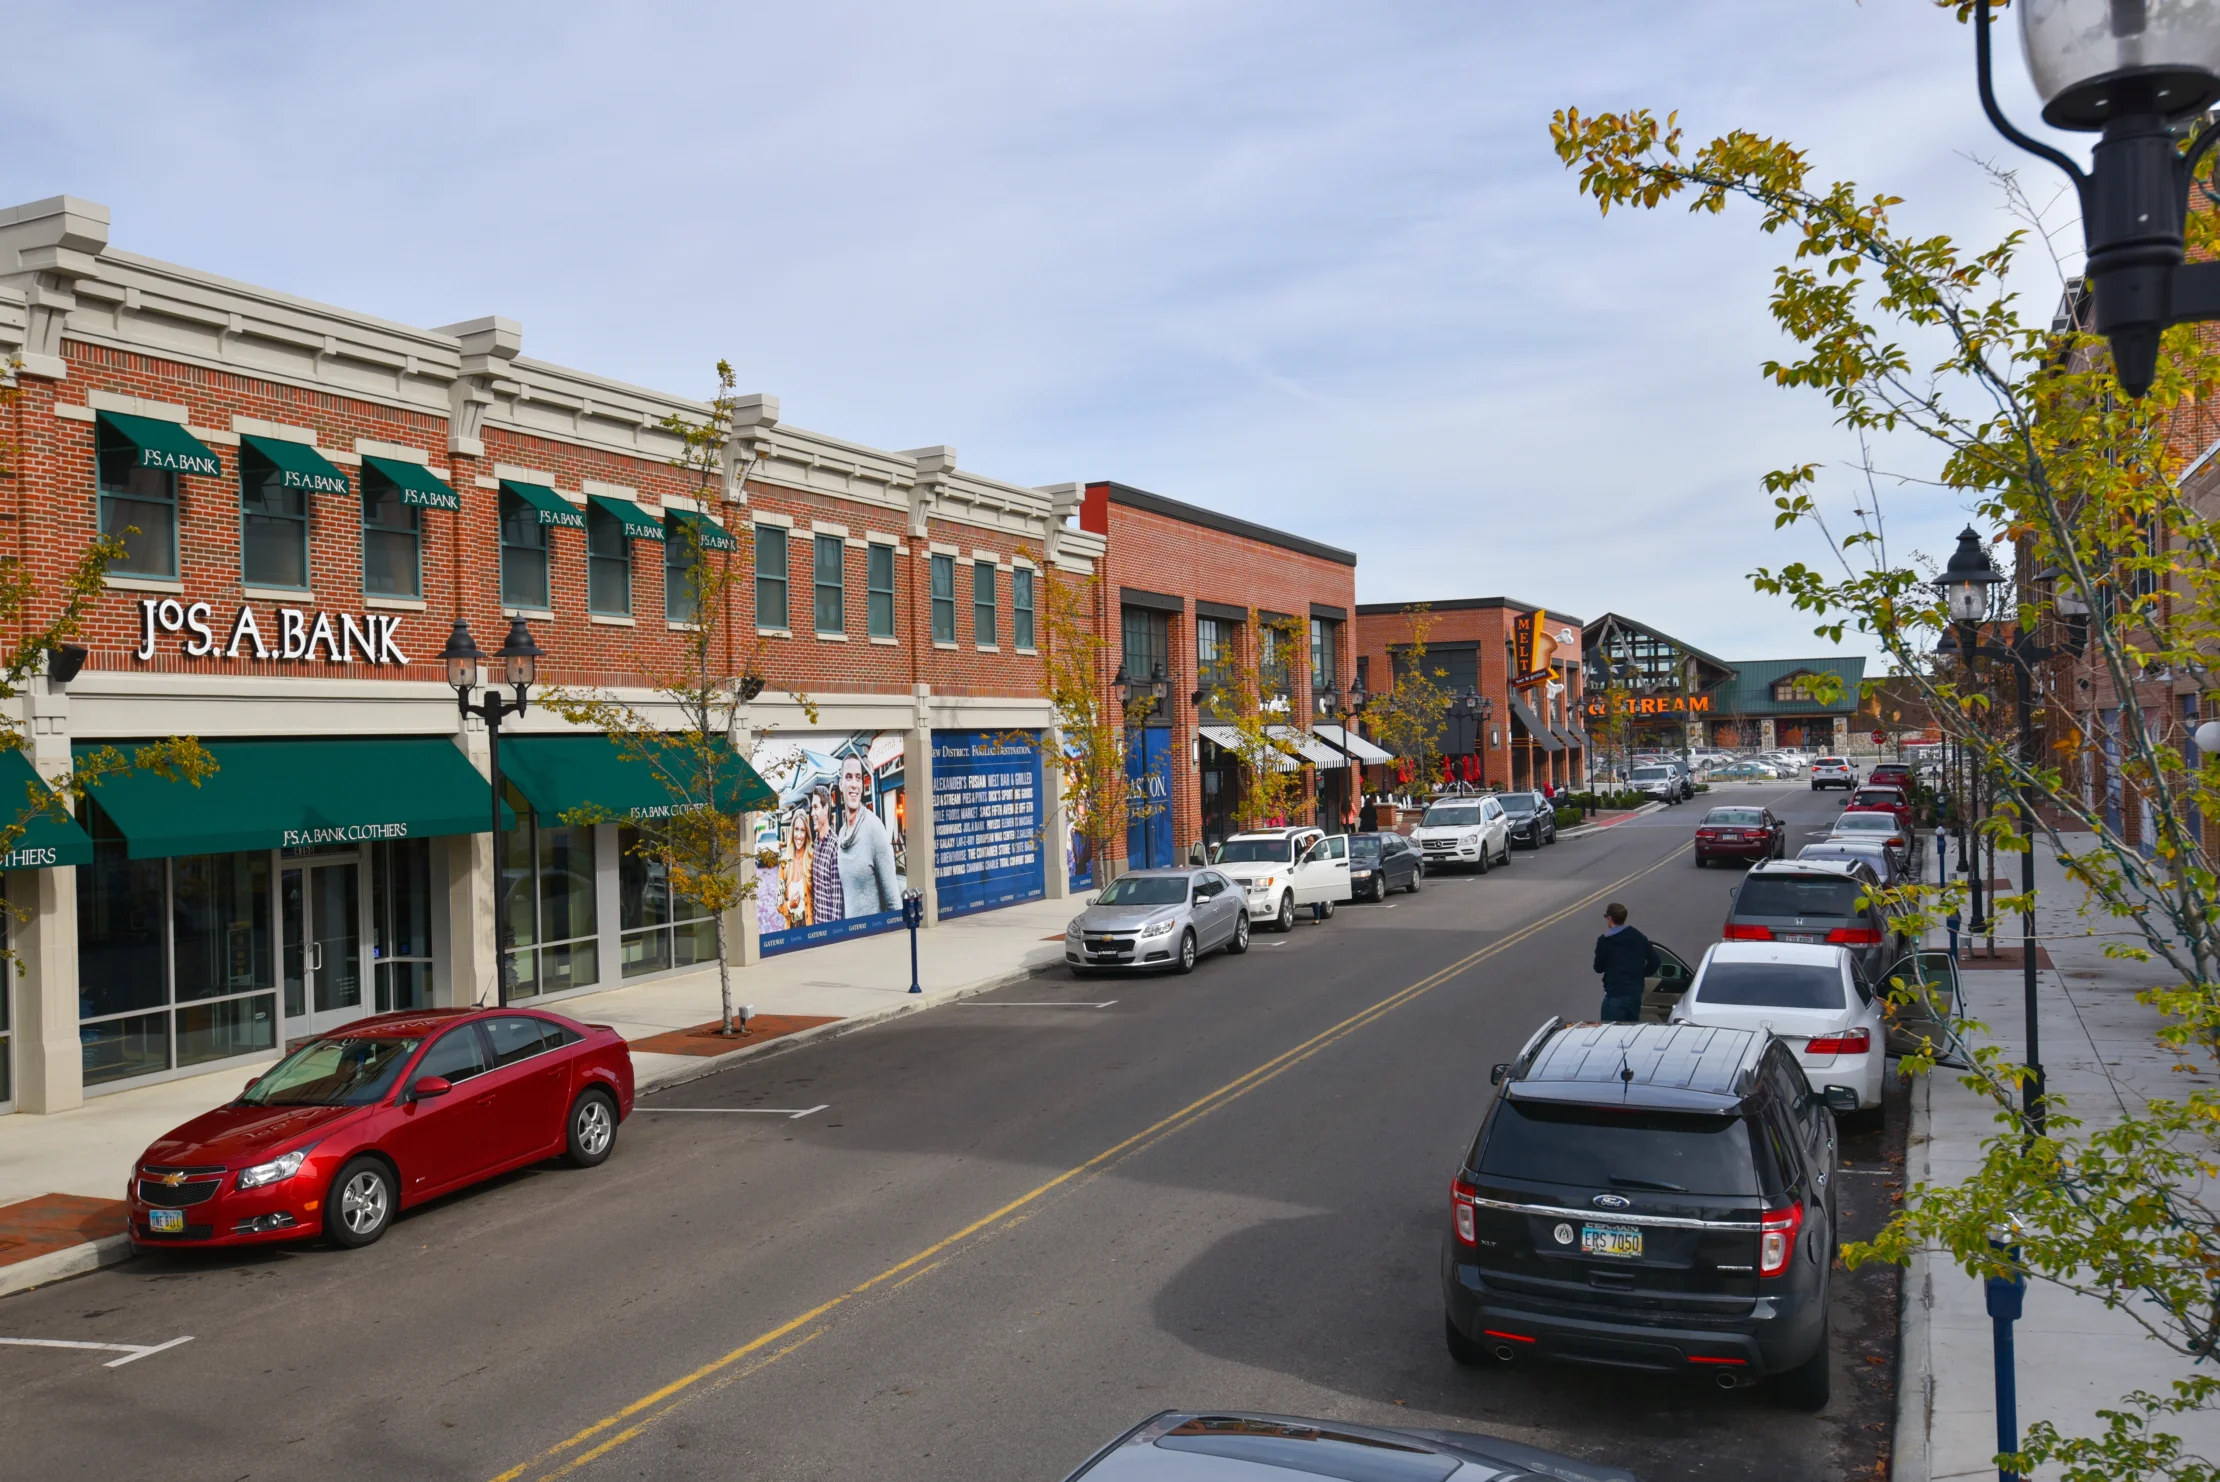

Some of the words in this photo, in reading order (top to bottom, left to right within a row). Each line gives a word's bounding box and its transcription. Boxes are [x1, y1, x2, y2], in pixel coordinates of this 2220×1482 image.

[179, 455, 218, 475] BANK
[314, 476, 347, 493] BANK
[430, 493, 458, 509] BANK
[281, 608, 411, 664] BANK
[1518, 619, 1531, 670] MELT
[1612, 695, 1708, 714] STREAM
[314, 827, 347, 842] BANK
[348, 822, 408, 841] CLOTHIERS
[0, 847, 57, 867] THIERS
[763, 938, 785, 948] GATEWAY
[807, 929, 828, 939] GATEWAY
[1600, 1196, 1621, 1207] Ford
[151, 1216, 163, 1227] ONE
[1480, 1239, 1497, 1247] XLT
[1585, 1231, 1606, 1248] ERS
[1610, 1233, 1639, 1251] 7050
